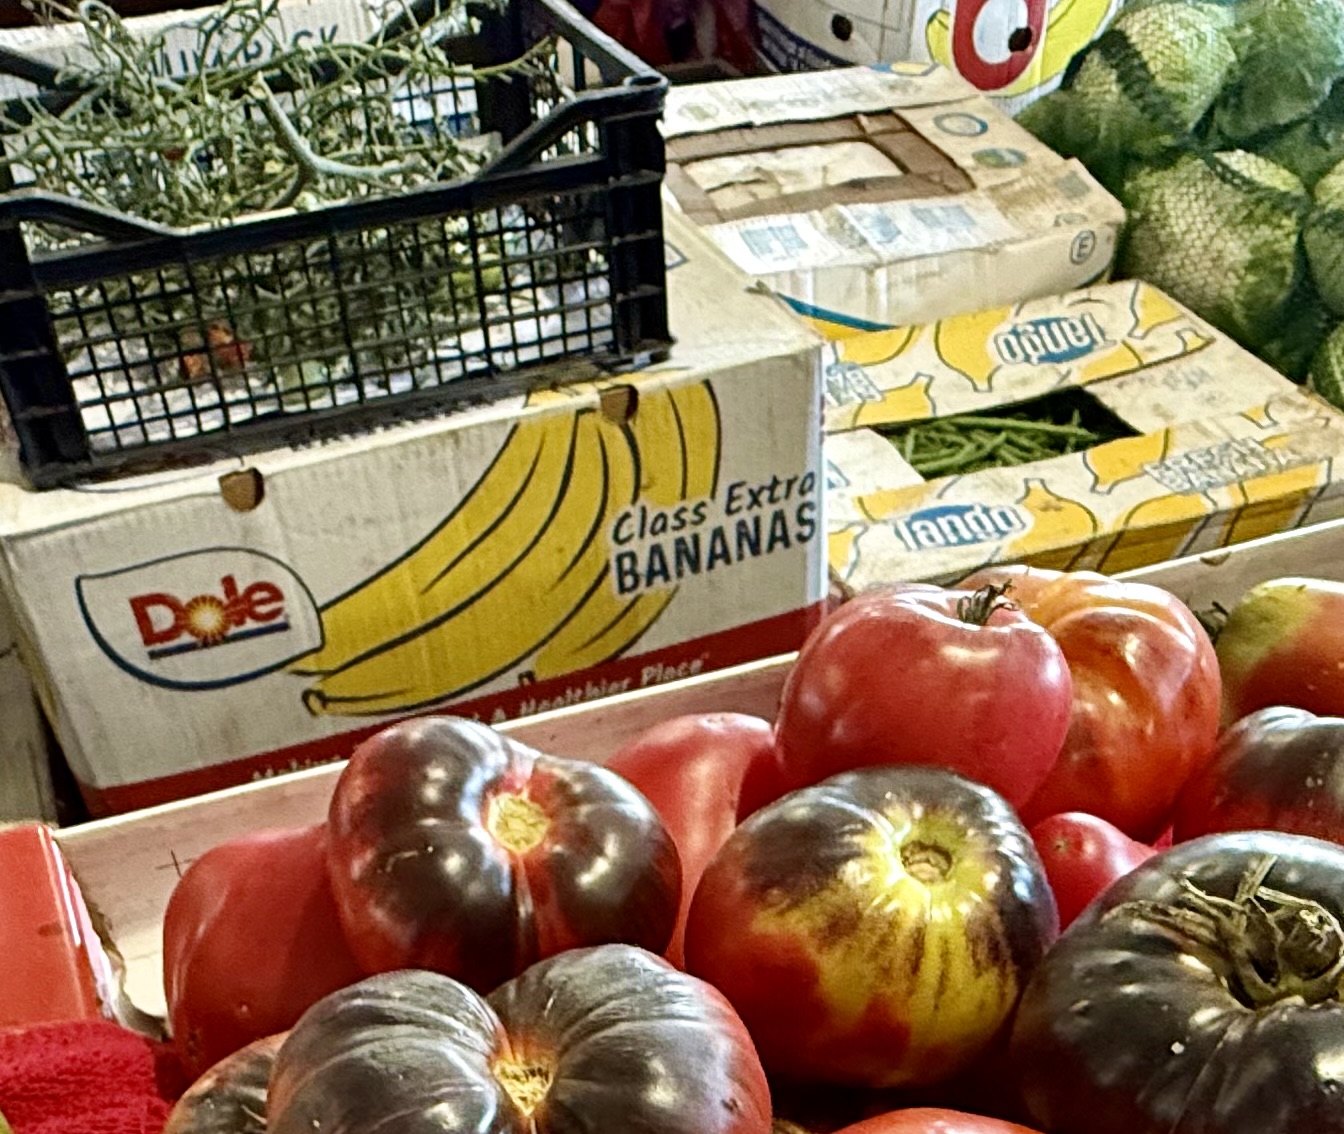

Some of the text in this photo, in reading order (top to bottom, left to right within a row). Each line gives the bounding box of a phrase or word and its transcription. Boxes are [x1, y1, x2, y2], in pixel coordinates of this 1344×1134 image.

[612, 472, 816, 546] Class Extra
[615, 501, 816, 595] BANANAS
[129, 574, 285, 647] Dole
[641, 658, 705, 687] Place
